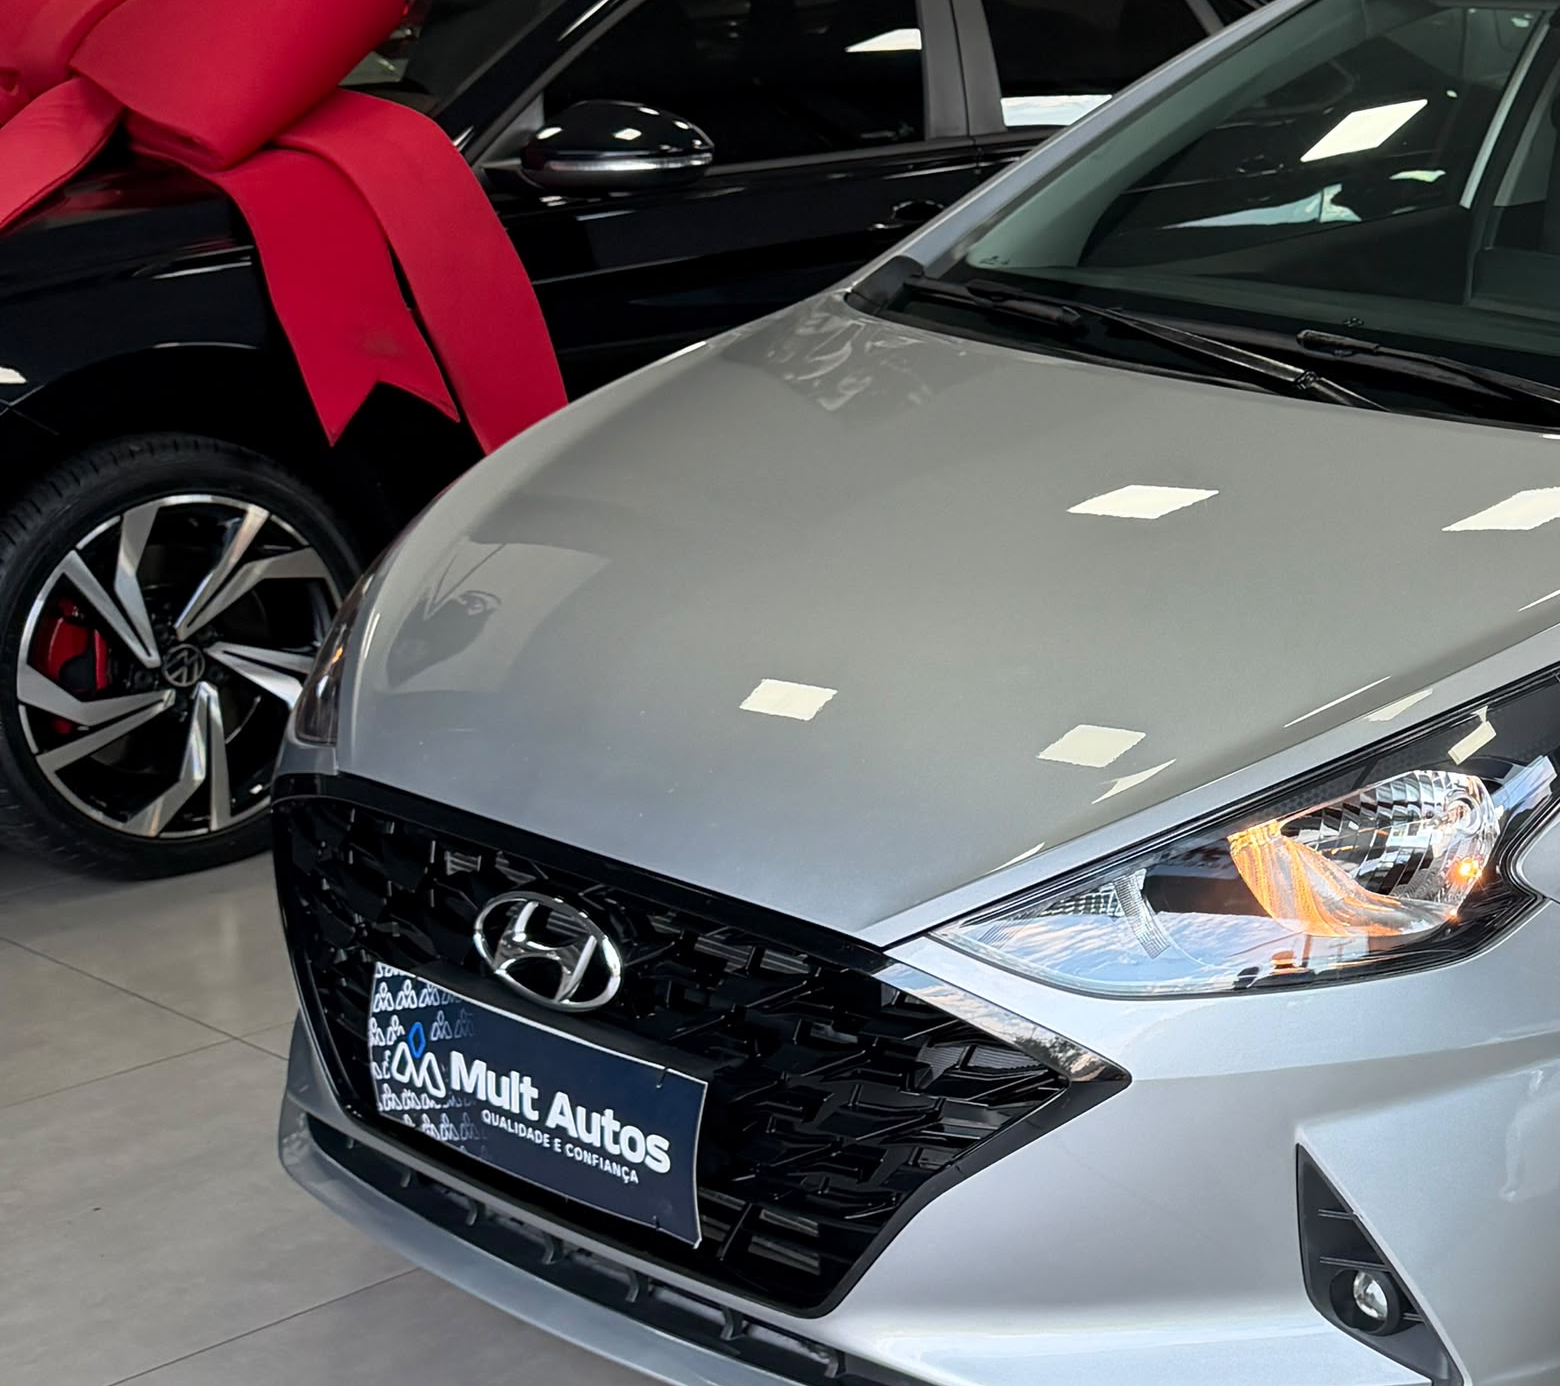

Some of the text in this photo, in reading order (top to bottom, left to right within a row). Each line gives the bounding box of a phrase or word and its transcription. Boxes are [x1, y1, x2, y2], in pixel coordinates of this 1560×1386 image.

[449, 1051, 671, 1174] Mult Autos
[481, 1109, 639, 1184] QUALIDADE E CONFIANÇA
